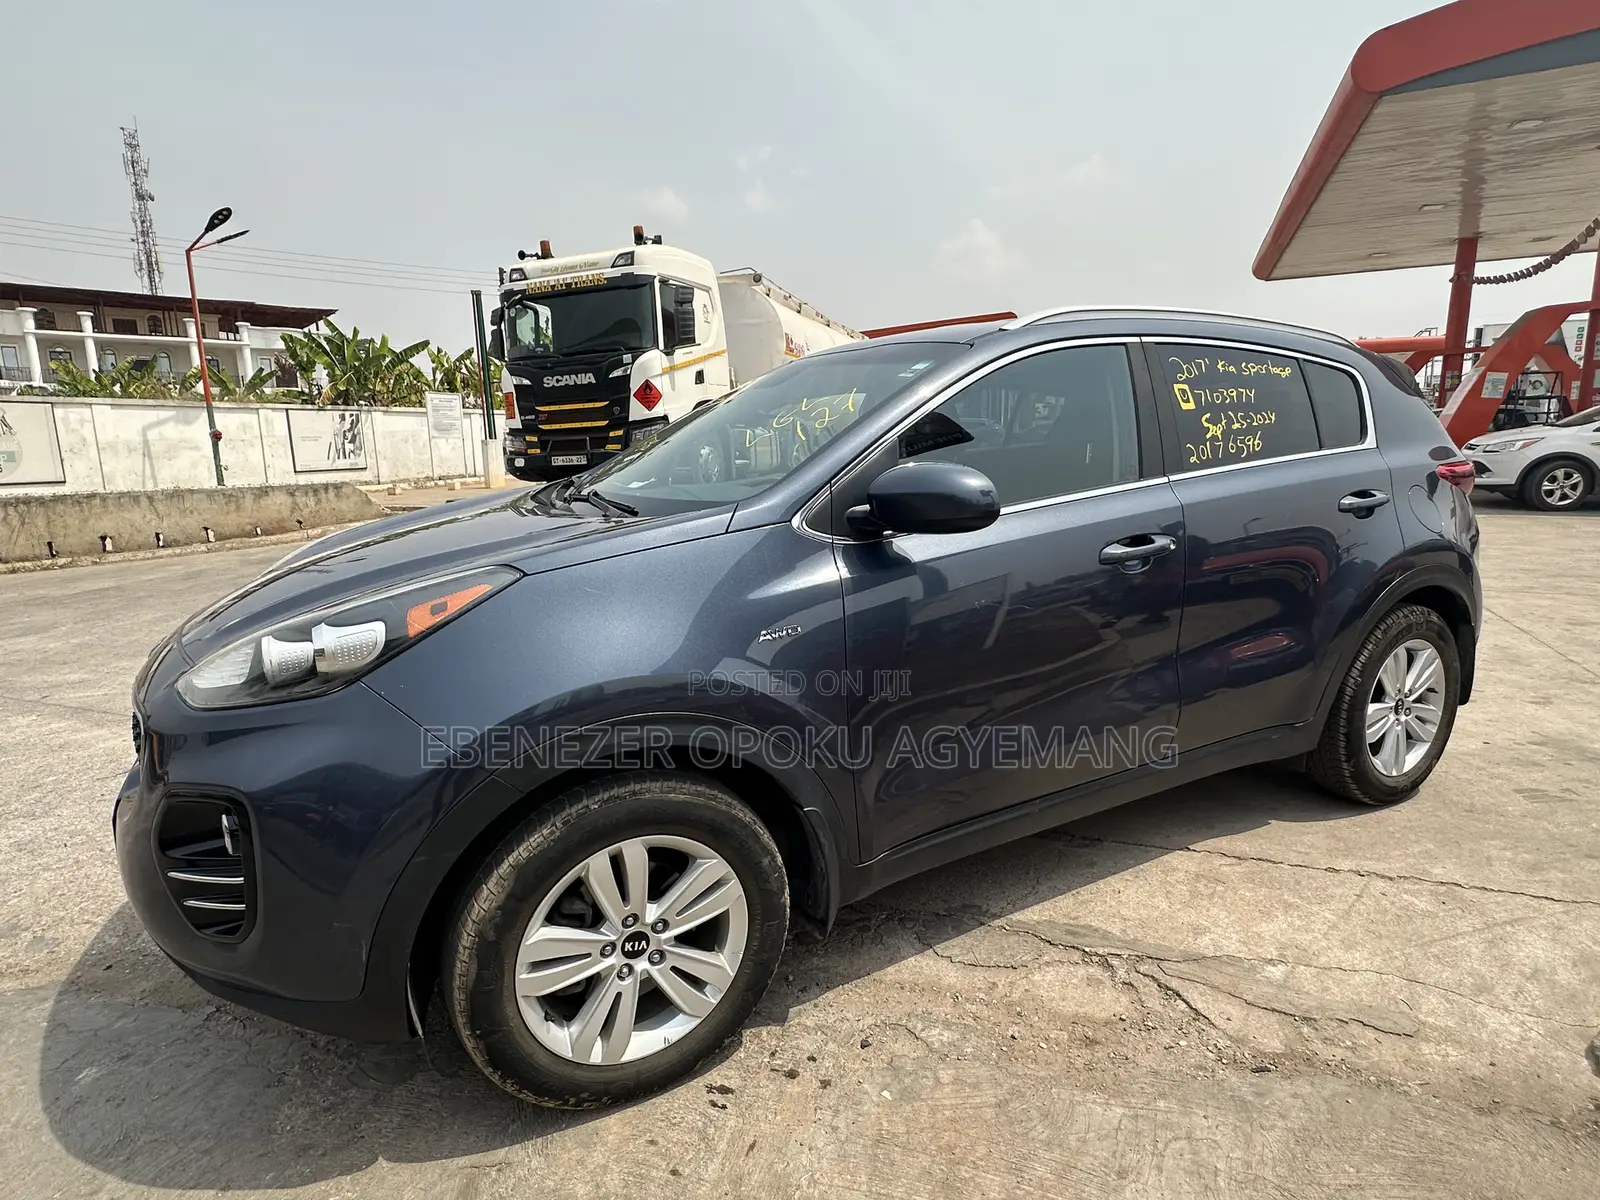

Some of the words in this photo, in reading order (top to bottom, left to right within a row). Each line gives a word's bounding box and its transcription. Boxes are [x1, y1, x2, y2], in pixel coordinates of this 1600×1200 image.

[525, 281, 553, 294] NANA
[543, 373, 596, 387] SCANIA
[758, 624, 802, 643] AWD
[624, 939, 648, 952] KIA
